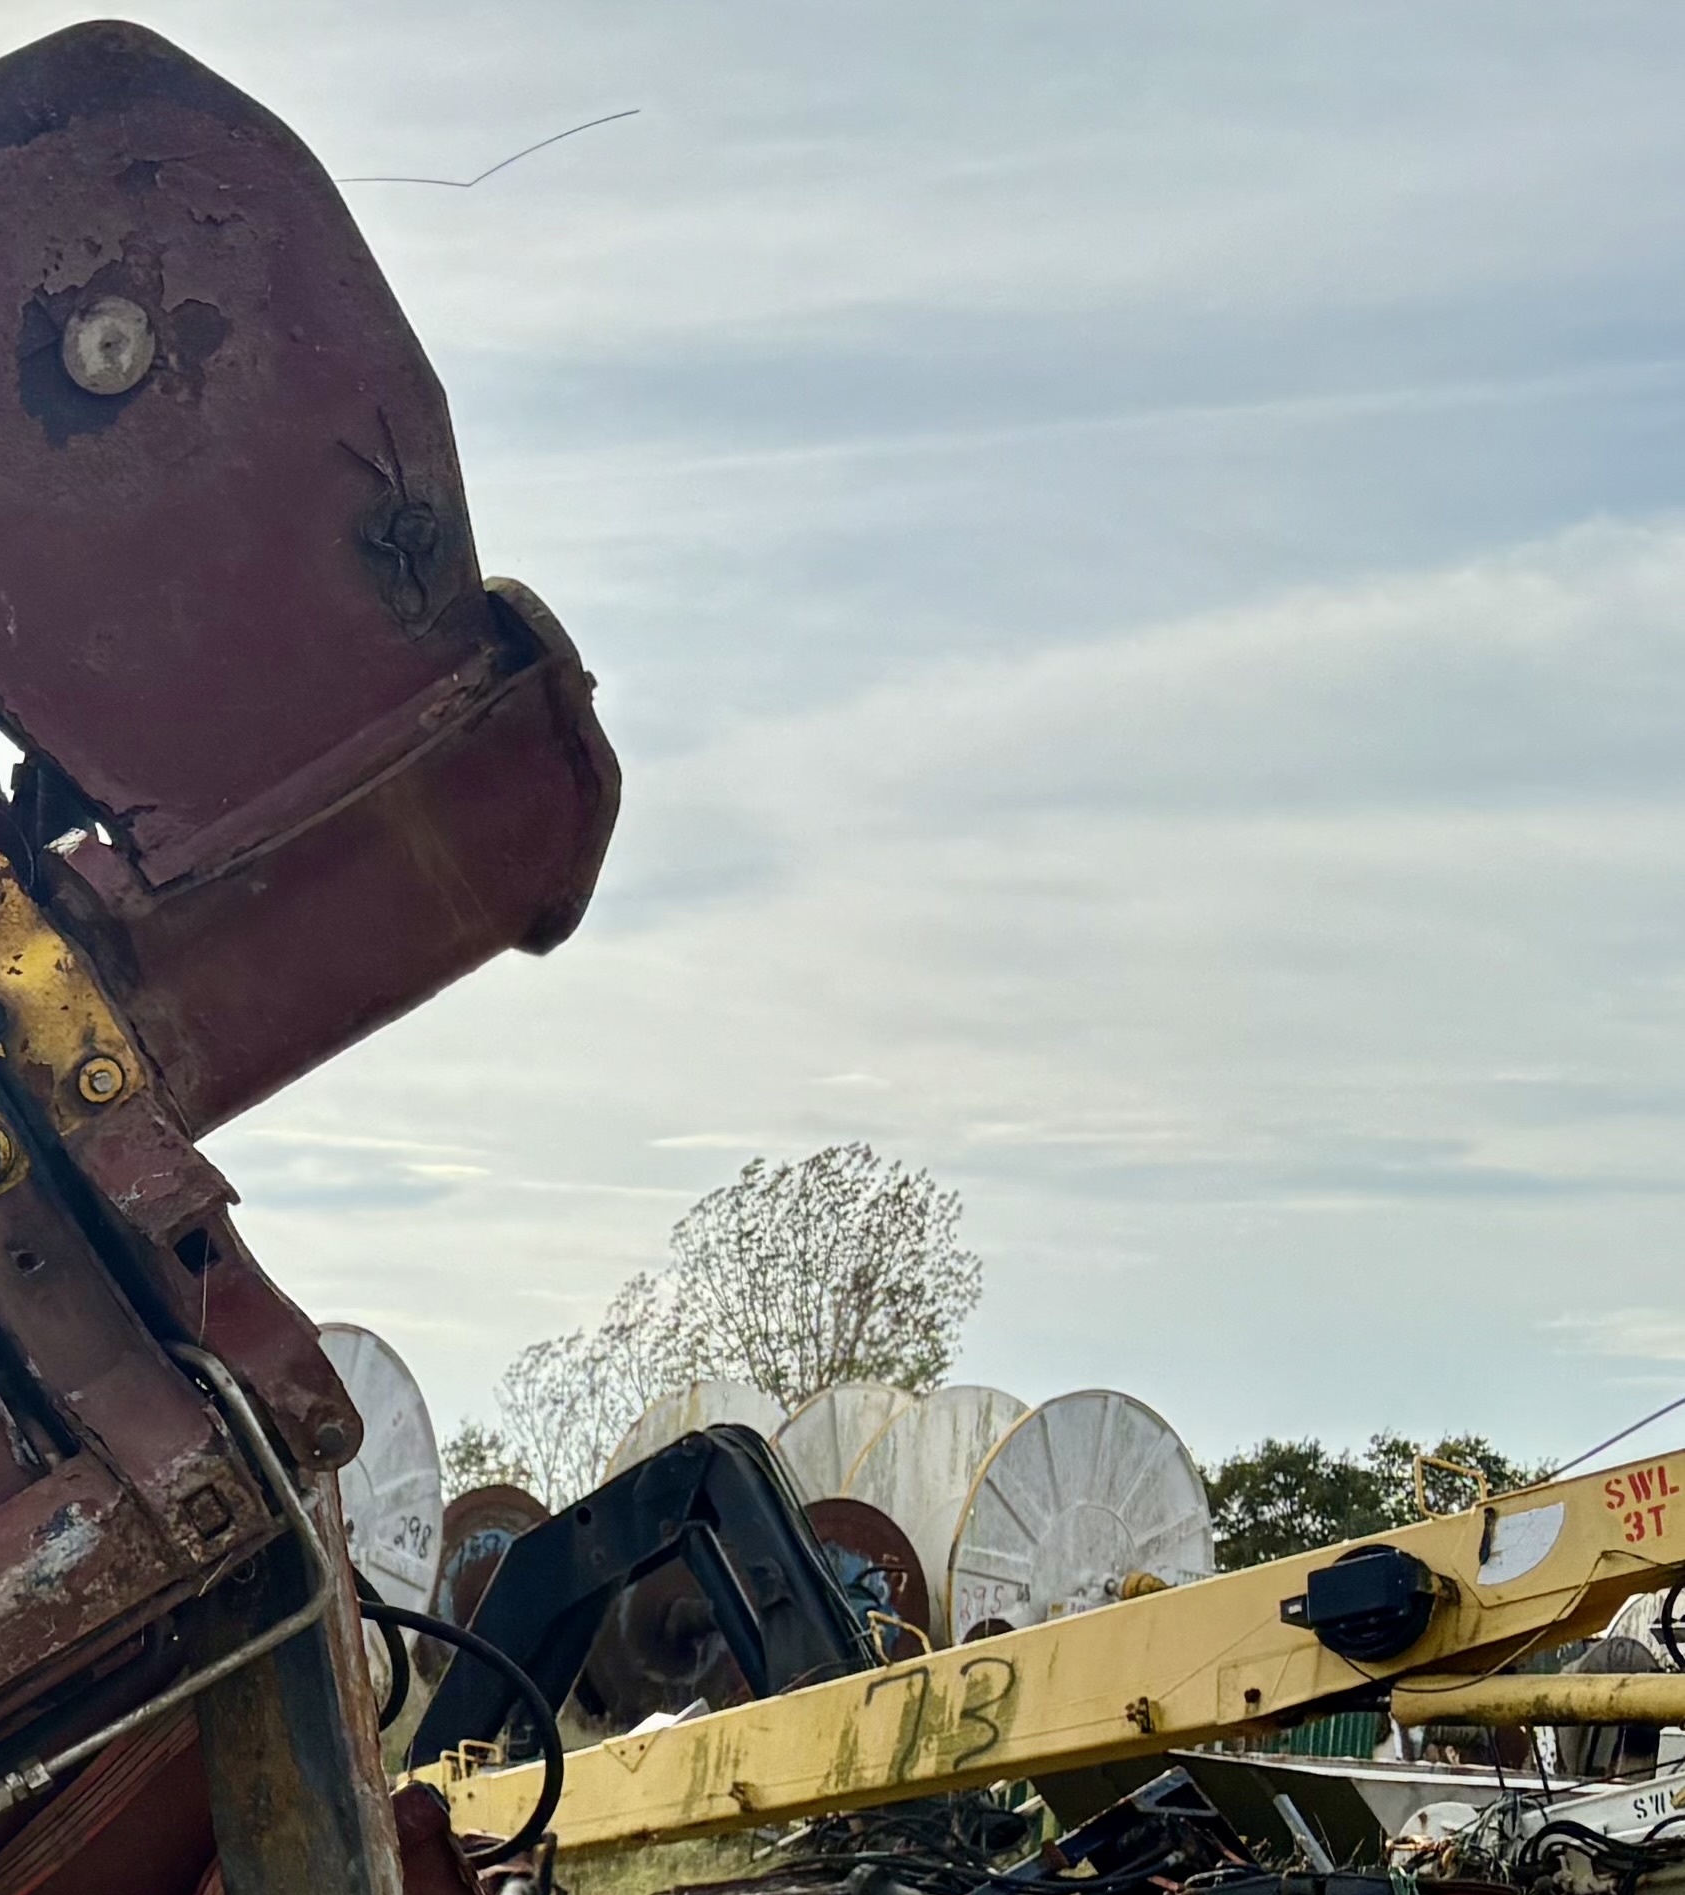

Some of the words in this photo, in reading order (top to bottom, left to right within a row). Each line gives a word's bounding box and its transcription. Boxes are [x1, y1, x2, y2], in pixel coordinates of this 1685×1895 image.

[1604, 1465, 1680, 1510] SWL
[393, 1516, 432, 1559] 298
[1623, 1503, 1666, 1542] 3T
[864, 1656, 1016, 1784] 73
